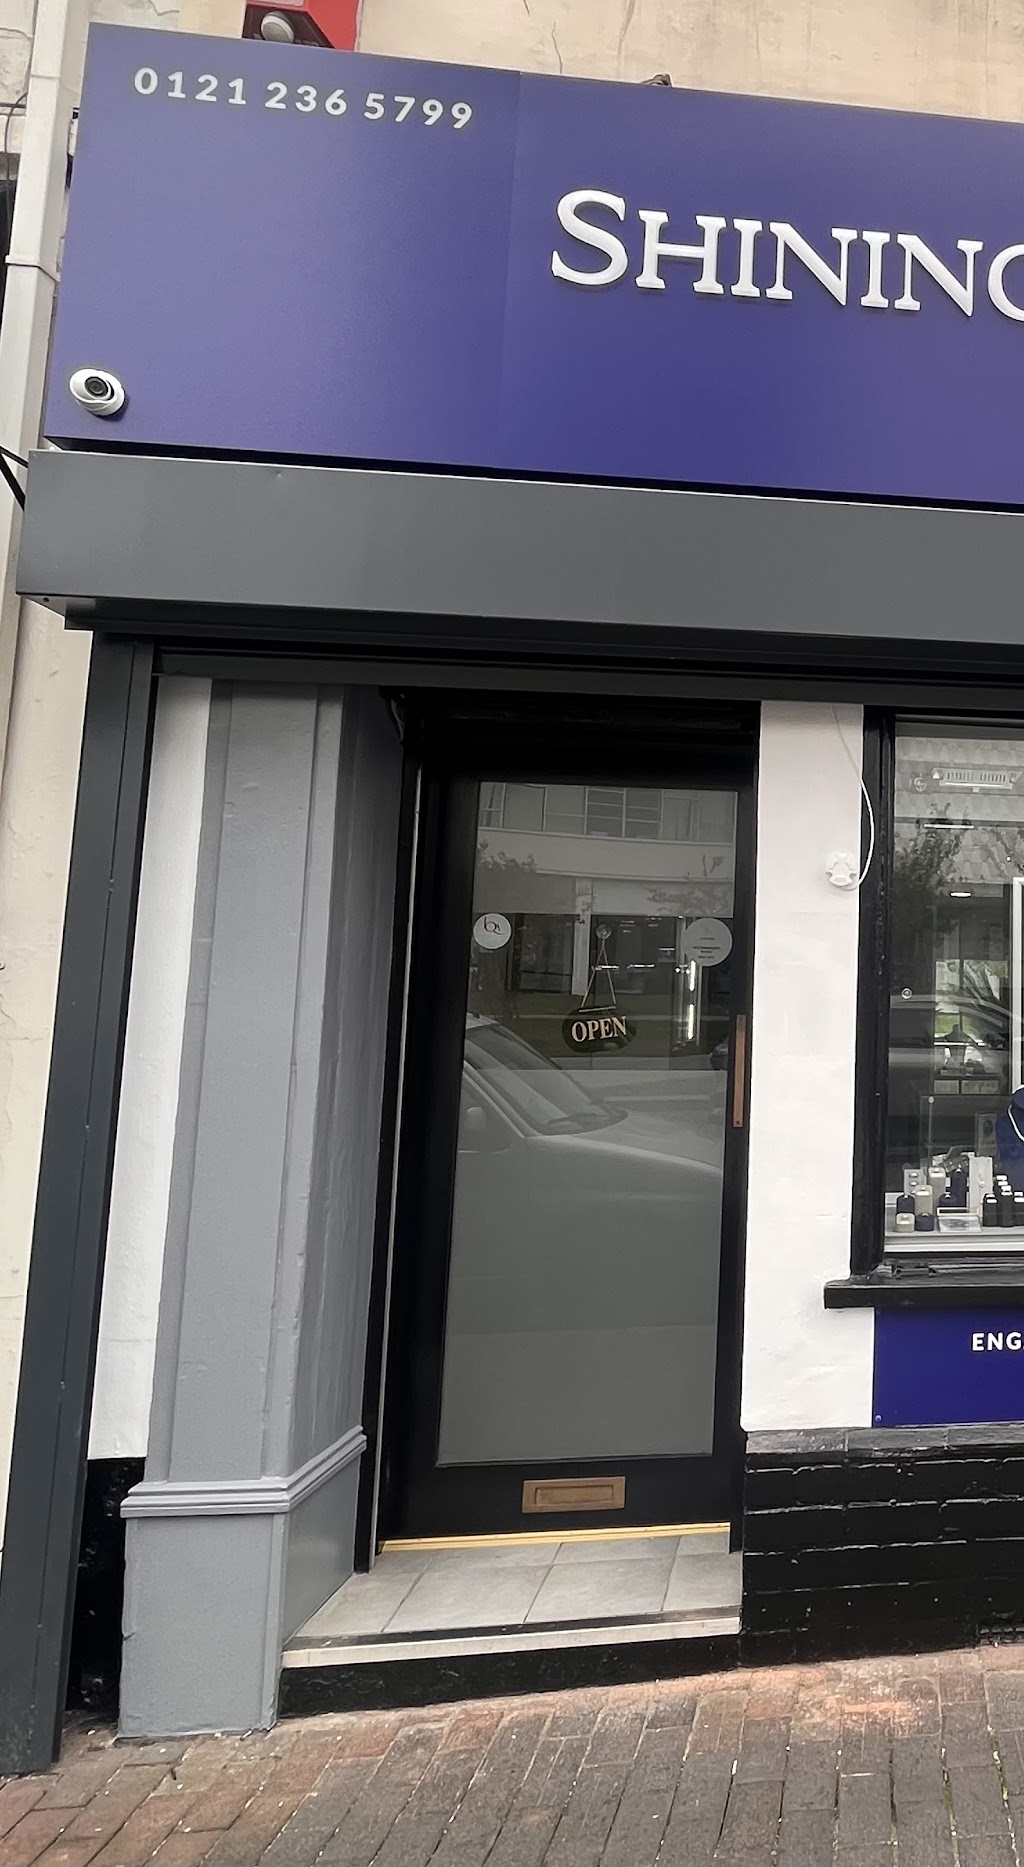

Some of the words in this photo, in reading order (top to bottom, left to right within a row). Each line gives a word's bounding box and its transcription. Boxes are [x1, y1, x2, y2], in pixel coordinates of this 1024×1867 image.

[134, 67, 247, 105] 0121
[264, 81, 348, 116] 236
[363, 92, 473, 129] 5799
[571, 1016, 627, 1043] OPEN
